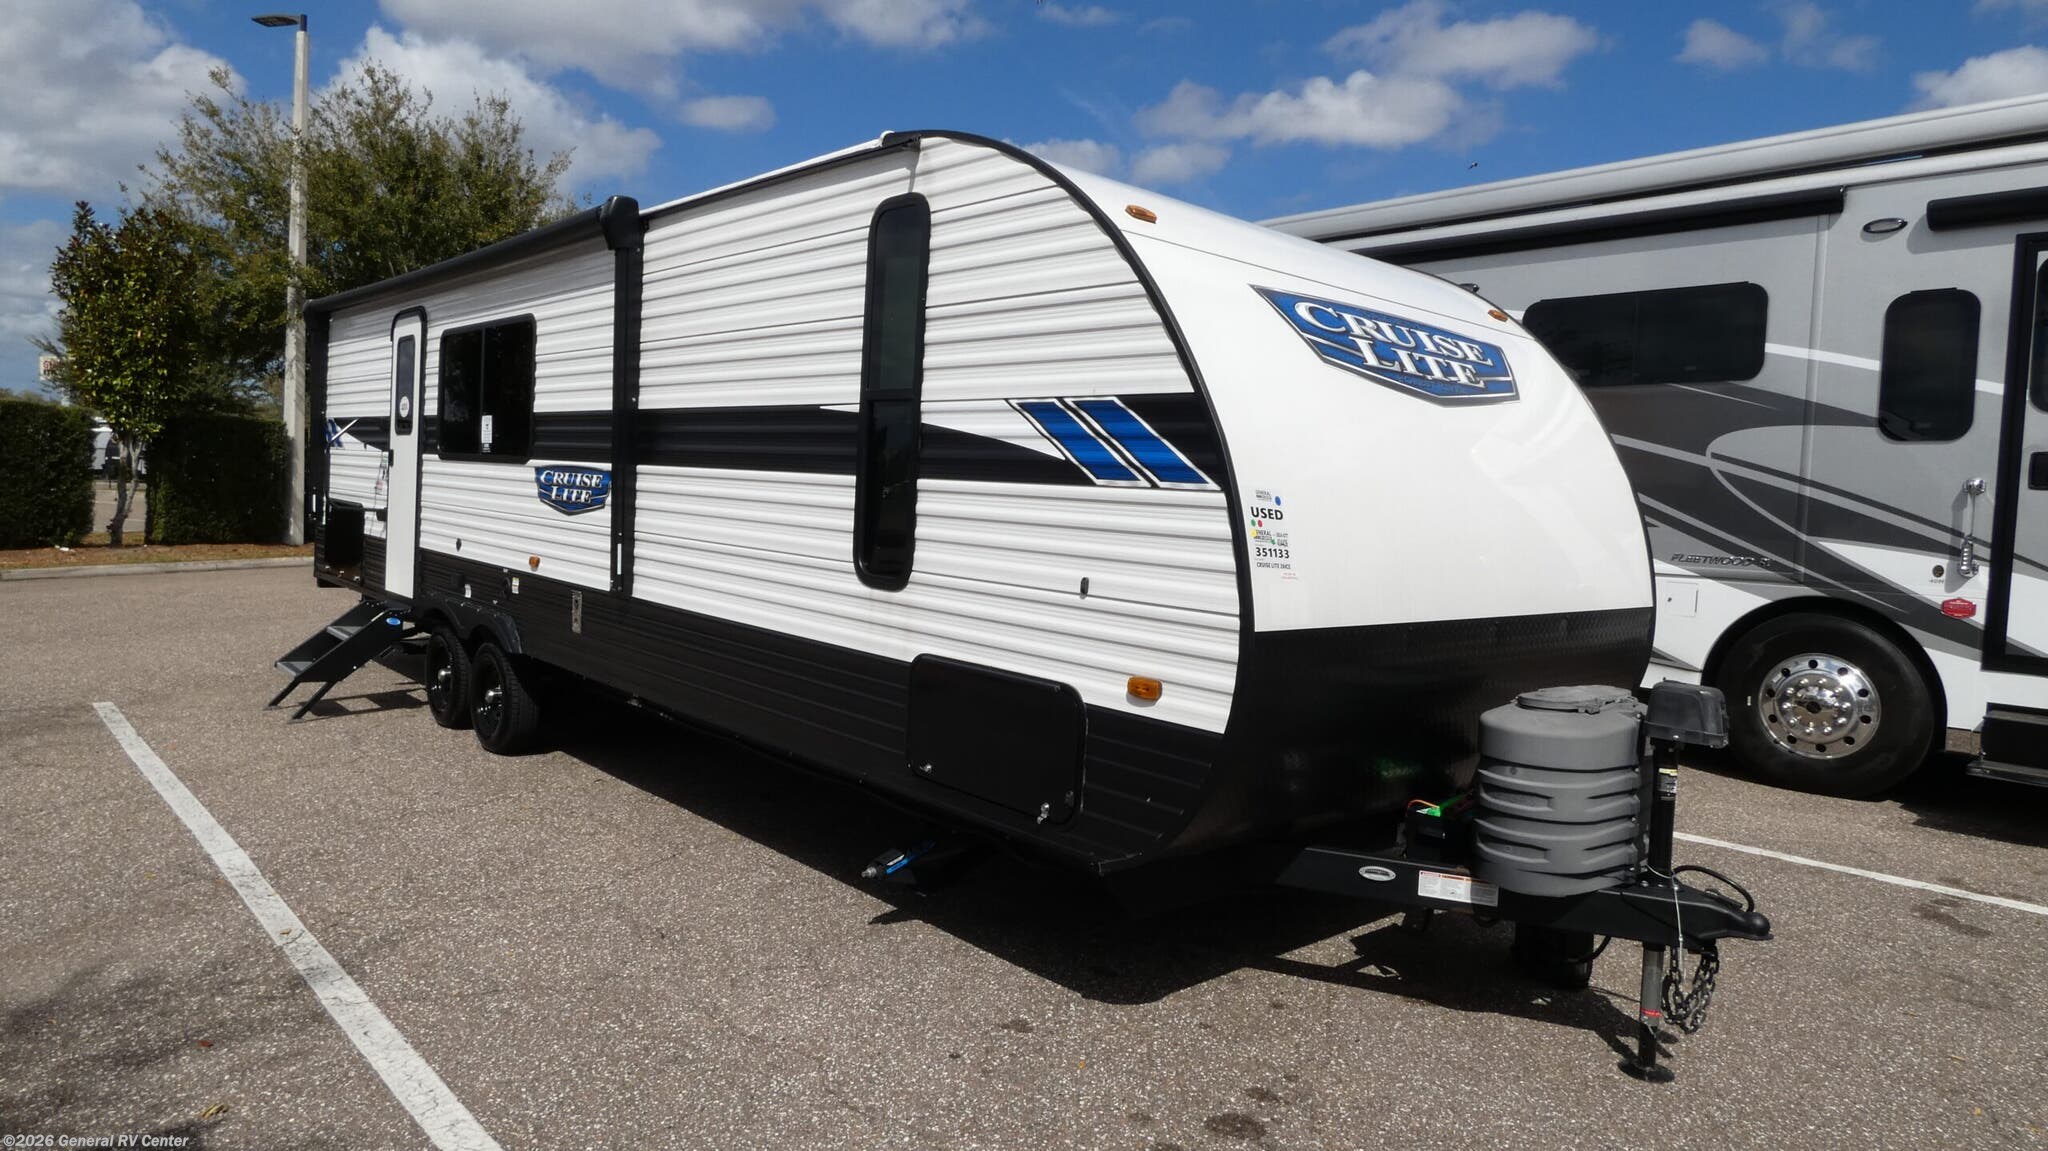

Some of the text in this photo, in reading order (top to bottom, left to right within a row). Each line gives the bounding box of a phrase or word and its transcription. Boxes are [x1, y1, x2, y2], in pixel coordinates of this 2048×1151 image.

[1294, 302, 1494, 367] CRUISE
[1348, 336, 1486, 389] LITE
[540, 470, 603, 488] CRUISE
[551, 486, 592, 503] LITE
[1250, 506, 1284, 520] USED
[1255, 547, 1290, 559] 351133
[1671, 553, 1756, 567] FLEETWOOD
